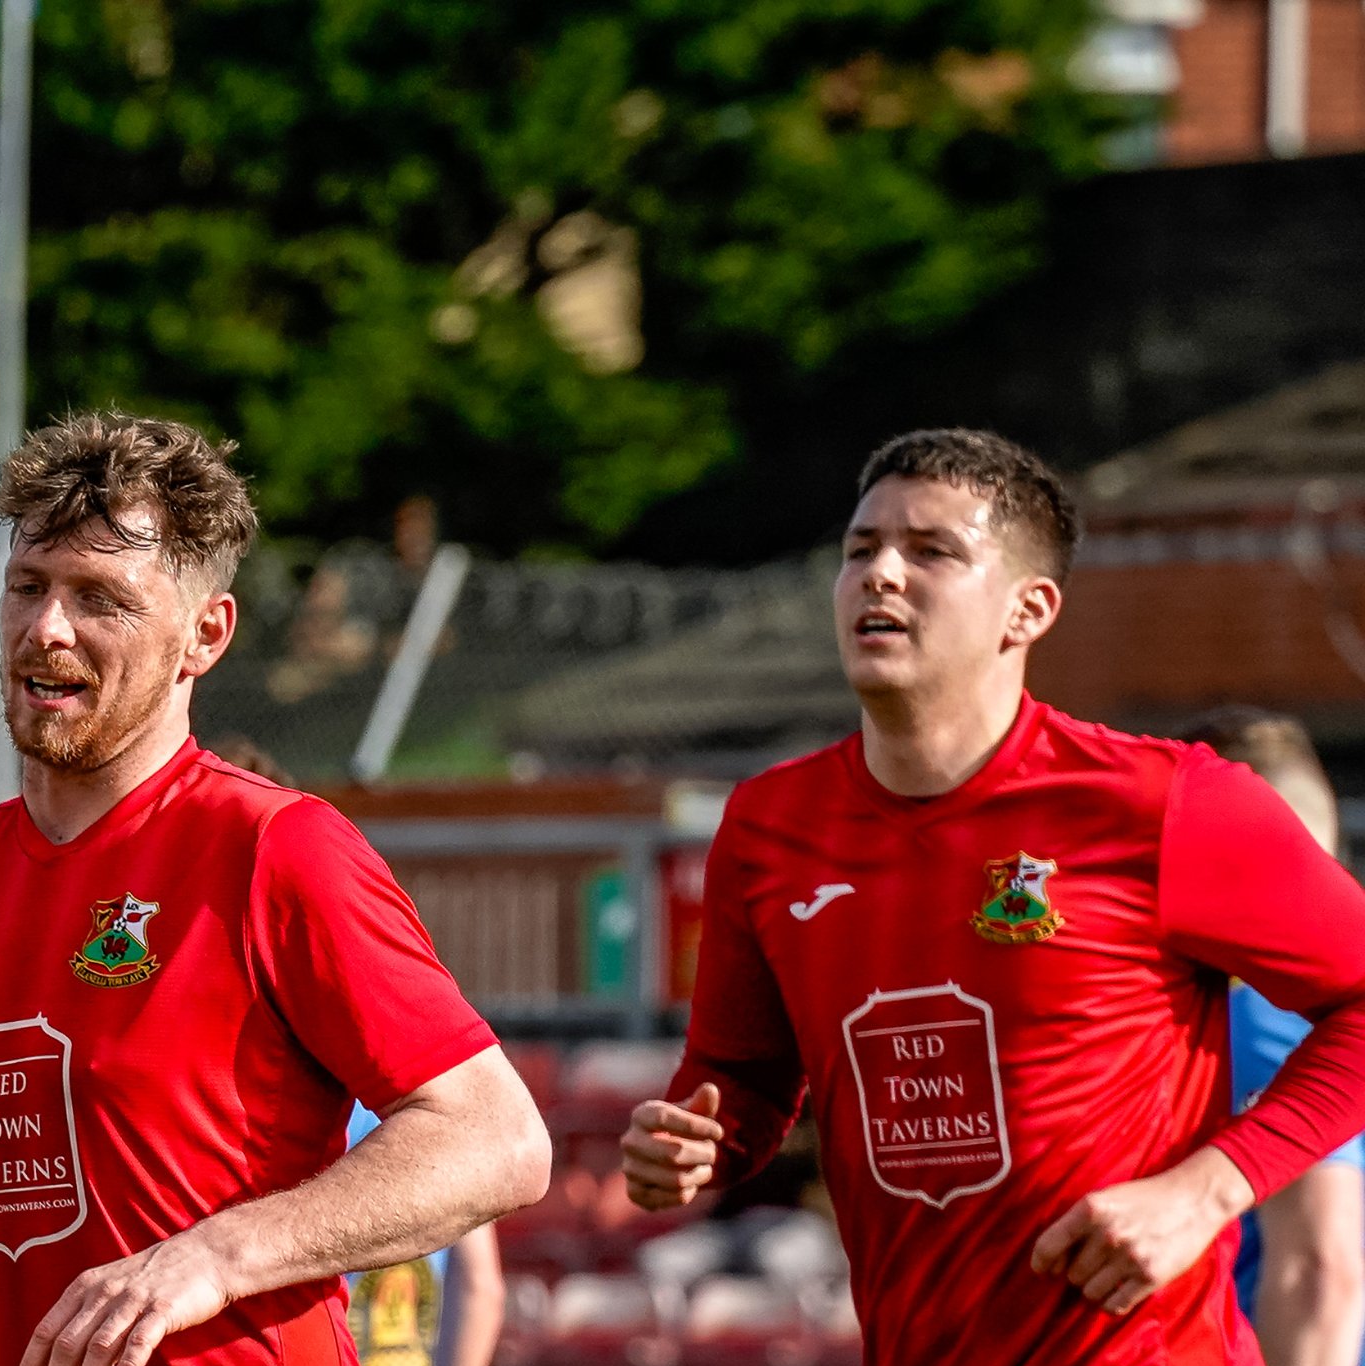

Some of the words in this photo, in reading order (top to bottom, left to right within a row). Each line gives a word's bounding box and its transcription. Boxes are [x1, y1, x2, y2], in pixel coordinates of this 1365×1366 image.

[892, 1034, 945, 1061] RED
[883, 1073, 965, 1104] TOWN
[871, 1111, 992, 1144] TAVERNS
